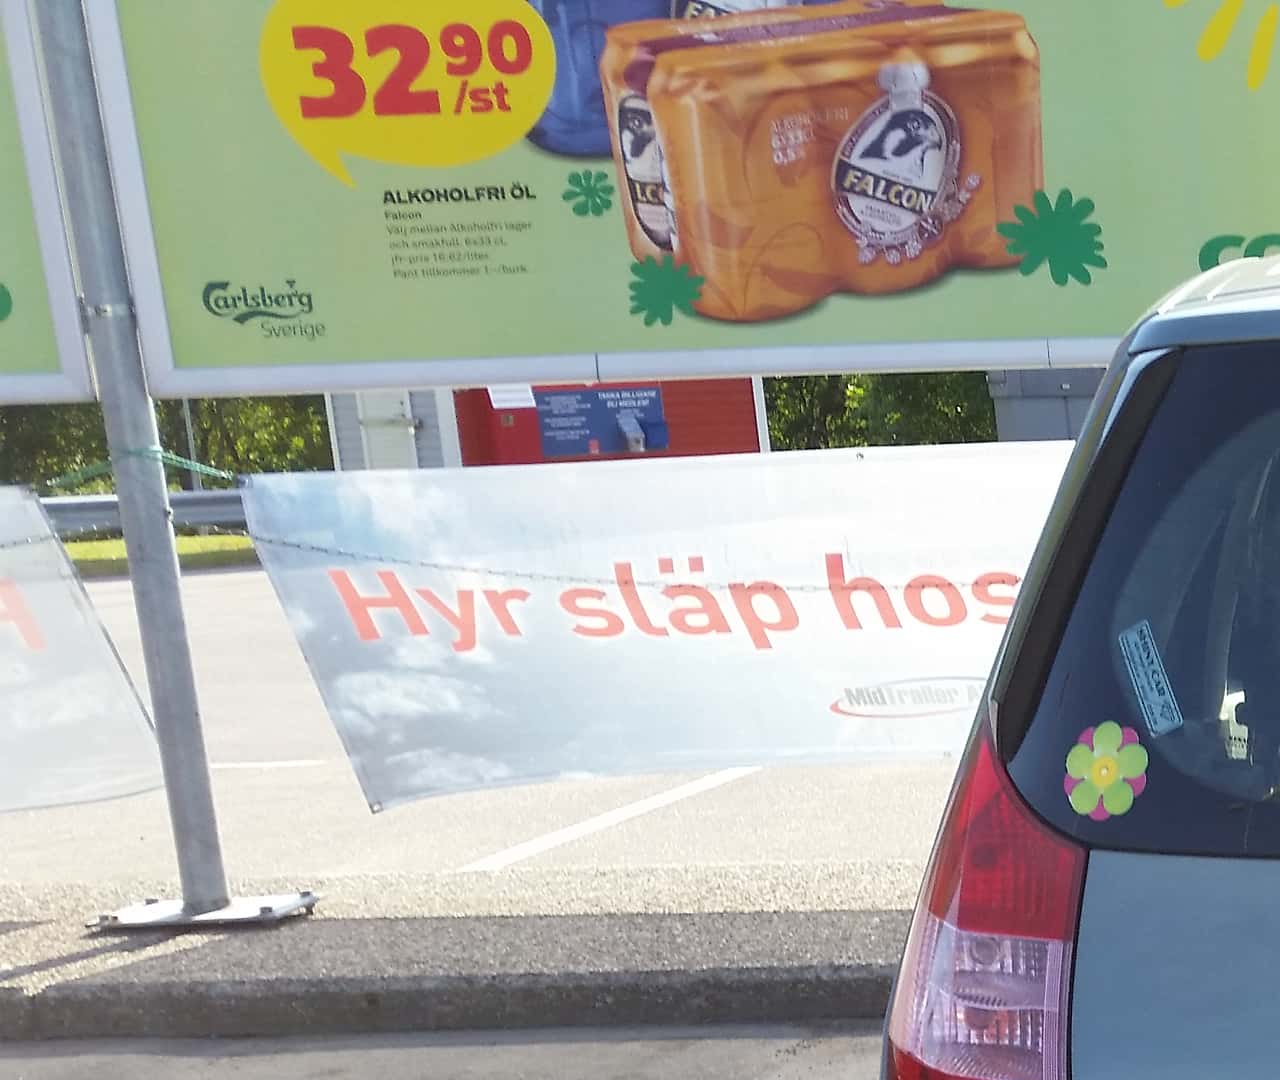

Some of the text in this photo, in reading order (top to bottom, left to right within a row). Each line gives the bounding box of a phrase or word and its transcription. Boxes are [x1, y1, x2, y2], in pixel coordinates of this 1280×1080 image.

[453, 79, 512, 116] /st
[383, 181, 536, 204] ALKOHOLFRI ÖL
[842, 167, 933, 212] FALCON
[384, 209, 422, 221] Falcon
[202, 279, 314, 325] Carlsberg
[260, 321, 327, 341] Sverige
[328, 552, 1024, 654] Hyr släp hos
